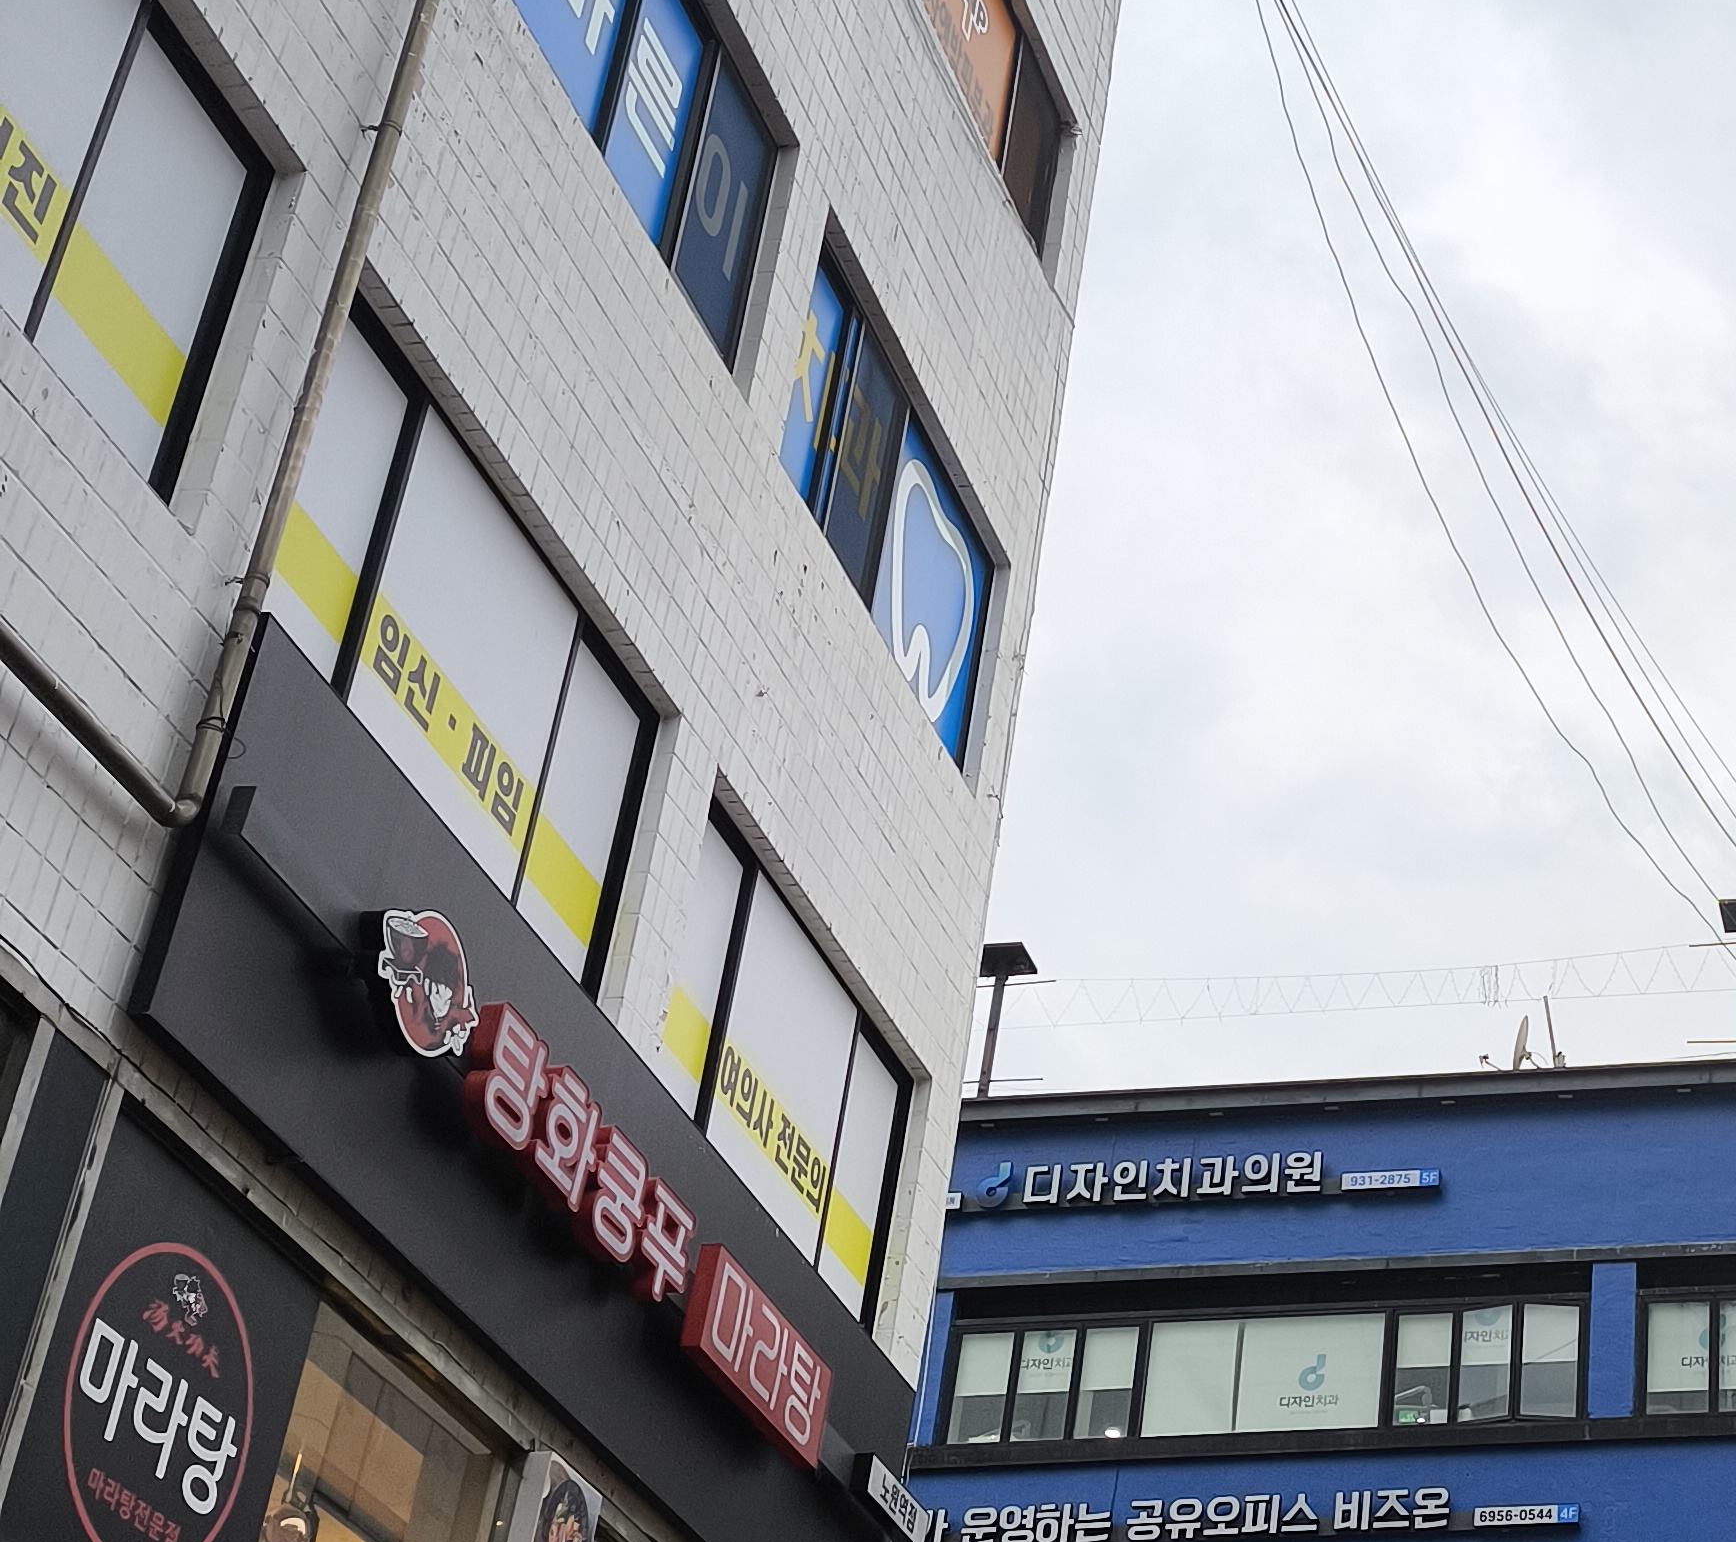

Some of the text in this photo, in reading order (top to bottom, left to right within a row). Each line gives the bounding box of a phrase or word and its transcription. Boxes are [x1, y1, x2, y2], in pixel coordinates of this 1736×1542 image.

[373, 614, 525, 837] 임신 피임
[485, 1008, 697, 1302] 탕화쿵푸
[720, 1045, 827, 1215] 여의사 전문의
[1022, 1151, 1325, 1205] 디자인치과의원
[1349, 1171, 1438, 1188] 931-2875 5F
[711, 1261, 823, 1447] 마라탕
[79, 1317, 238, 1516] 마라탕
[1278, 1393, 1340, 1409] 디자인치과
[879, 1473, 918, 1534] 노원역점
[1125, 1492, 1318, 1542] 공유오피스
[1333, 1486, 1451, 1533] 비즈온
[1478, 1504, 1578, 1524] 6956-0544 4F
